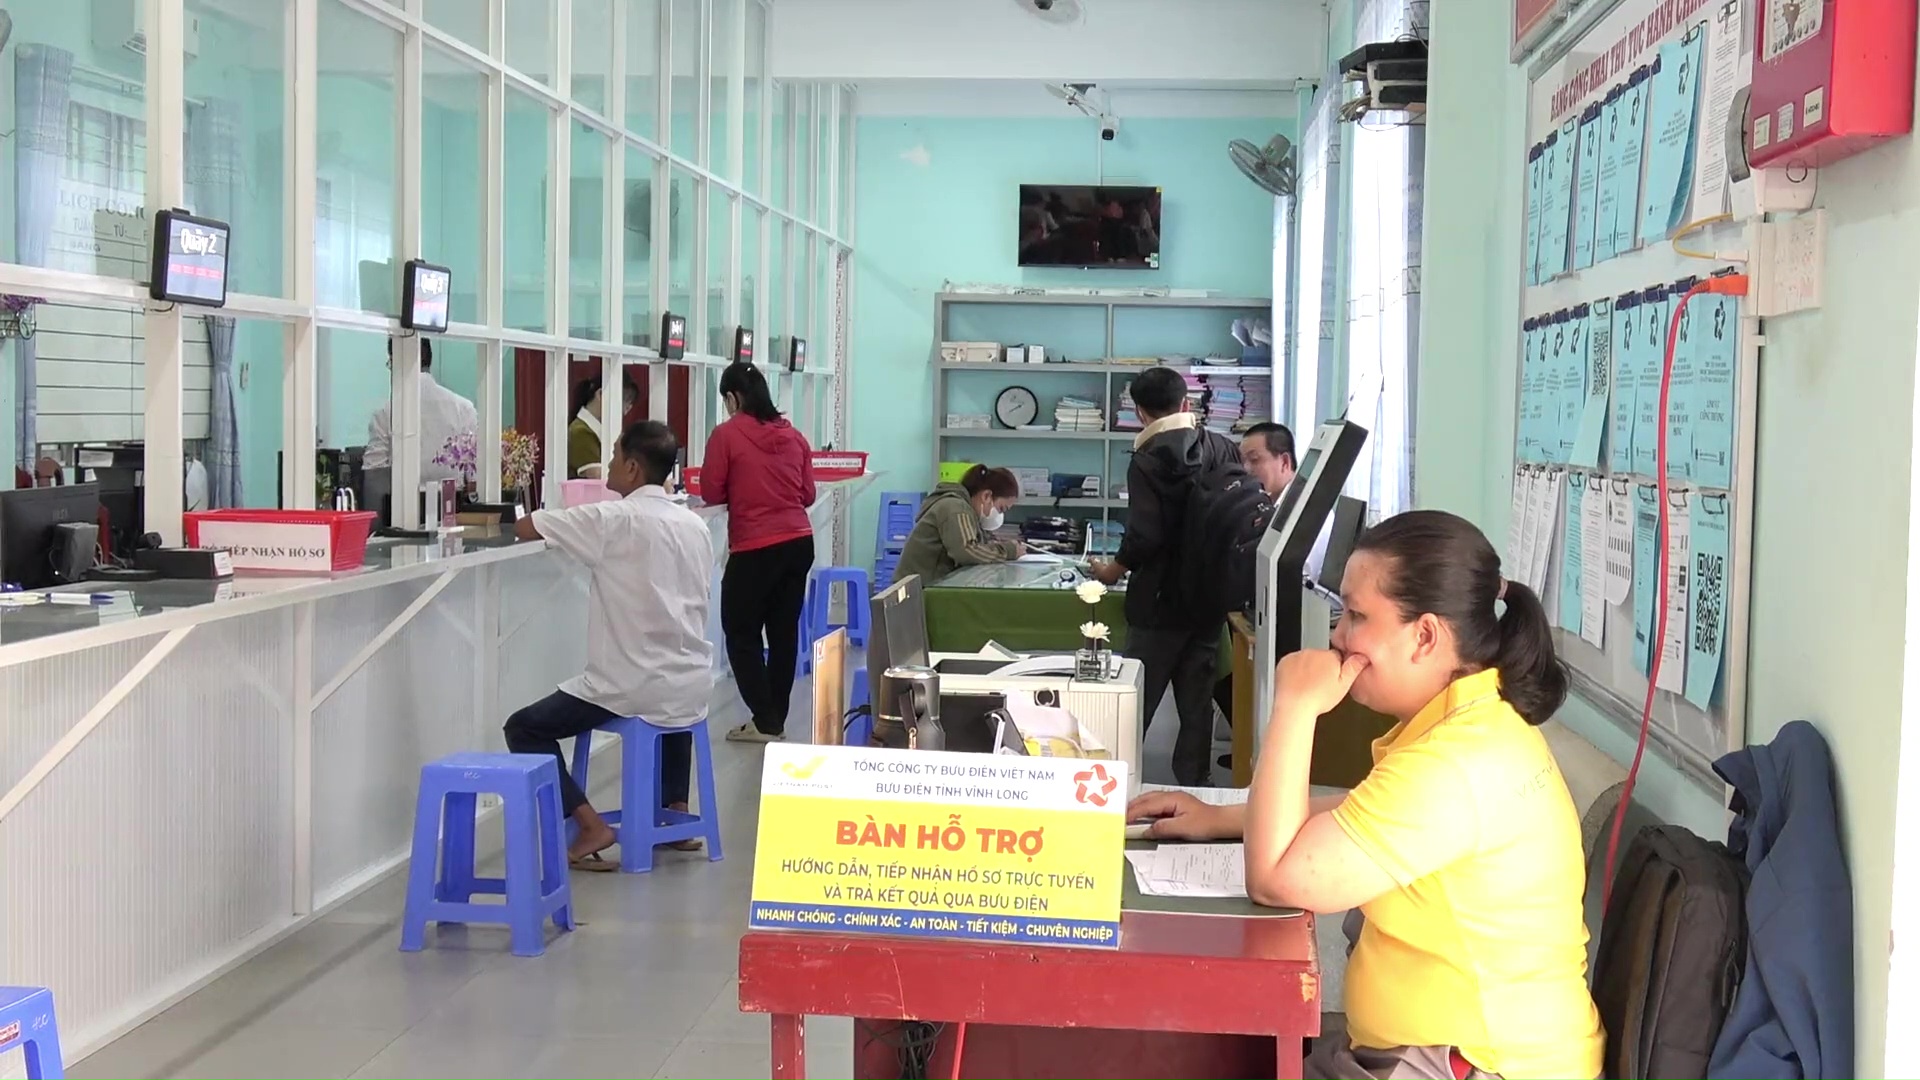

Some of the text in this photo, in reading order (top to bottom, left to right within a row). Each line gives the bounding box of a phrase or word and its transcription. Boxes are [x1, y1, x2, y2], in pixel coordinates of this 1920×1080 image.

[1589, 50, 1609, 93] KHAI
[180, 228, 217, 256] Quầy 2
[251, 547, 285, 559] NHẬN
[888, 761, 921, 775] CÔNG
[925, 764, 938, 775] TY
[941, 765, 965, 777] BƯU
[1028, 770, 1055, 781] NAM
[876, 782, 900, 794] BƯU
[997, 788, 1029, 801] LONG
[836, 813, 1044, 863] BÀN HỖ TRỢ
[781, 857, 834, 875] HƯỚNG
[838, 857, 872, 880] DẪN,
[877, 860, 907, 879] TIẾP
[911, 864, 953, 885] NHẬN
[982, 869, 1002, 884] SƠ
[1006, 870, 1043, 890] TRỰC
[1047, 870, 1095, 890] TUYẾN
[823, 882, 1049, 914] VÀ TRẢ KẾT QUẢ QUA BƯU ĐIỆN
[756, 908, 795, 922] NHANH
[797, 908, 836, 924] CHÓNG
[844, 911, 878, 927] CHÍNH
[880, 913, 902, 928] XÁC
[910, 917, 926, 930] AN
[928, 917, 958, 931] TOÀN
[967, 917, 989, 933] TIẾT
[991, 920, 1017, 937] KIỆM
[1026, 923, 1070, 938] CHUYÊN
[1072, 925, 1113, 942] NGHIỆP
